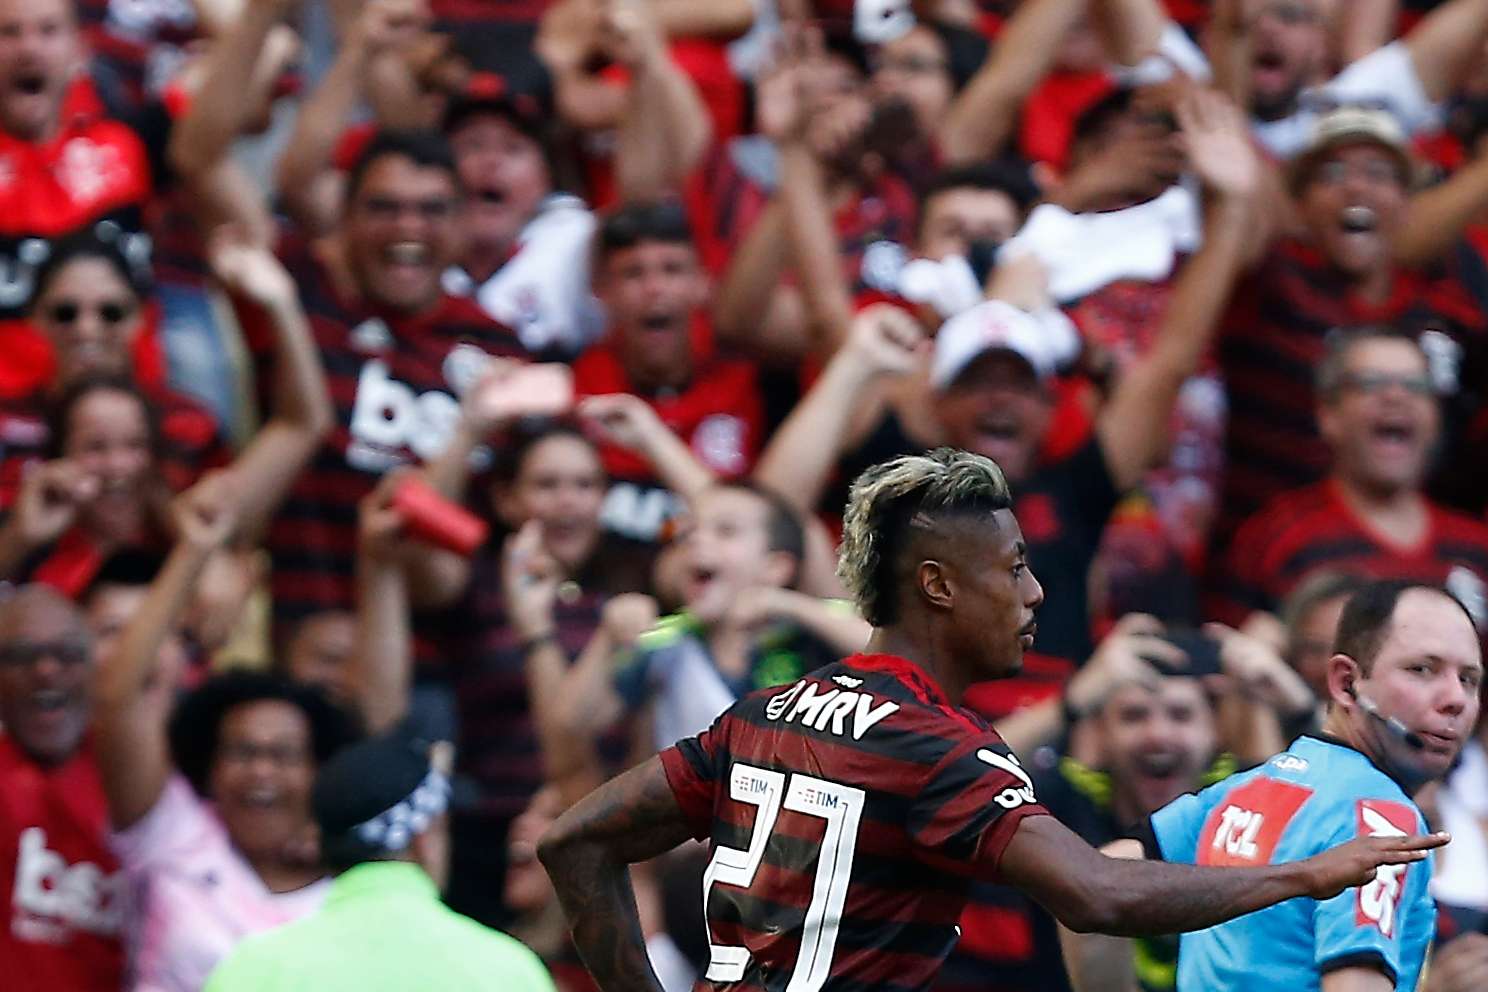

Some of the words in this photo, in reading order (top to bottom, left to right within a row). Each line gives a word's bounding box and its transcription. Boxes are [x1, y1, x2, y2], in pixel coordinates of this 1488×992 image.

[785, 680, 899, 740] MRV
[750, 777, 769, 795] TIM
[815, 790, 840, 809] TIM
[1212, 804, 1264, 861] TCL
